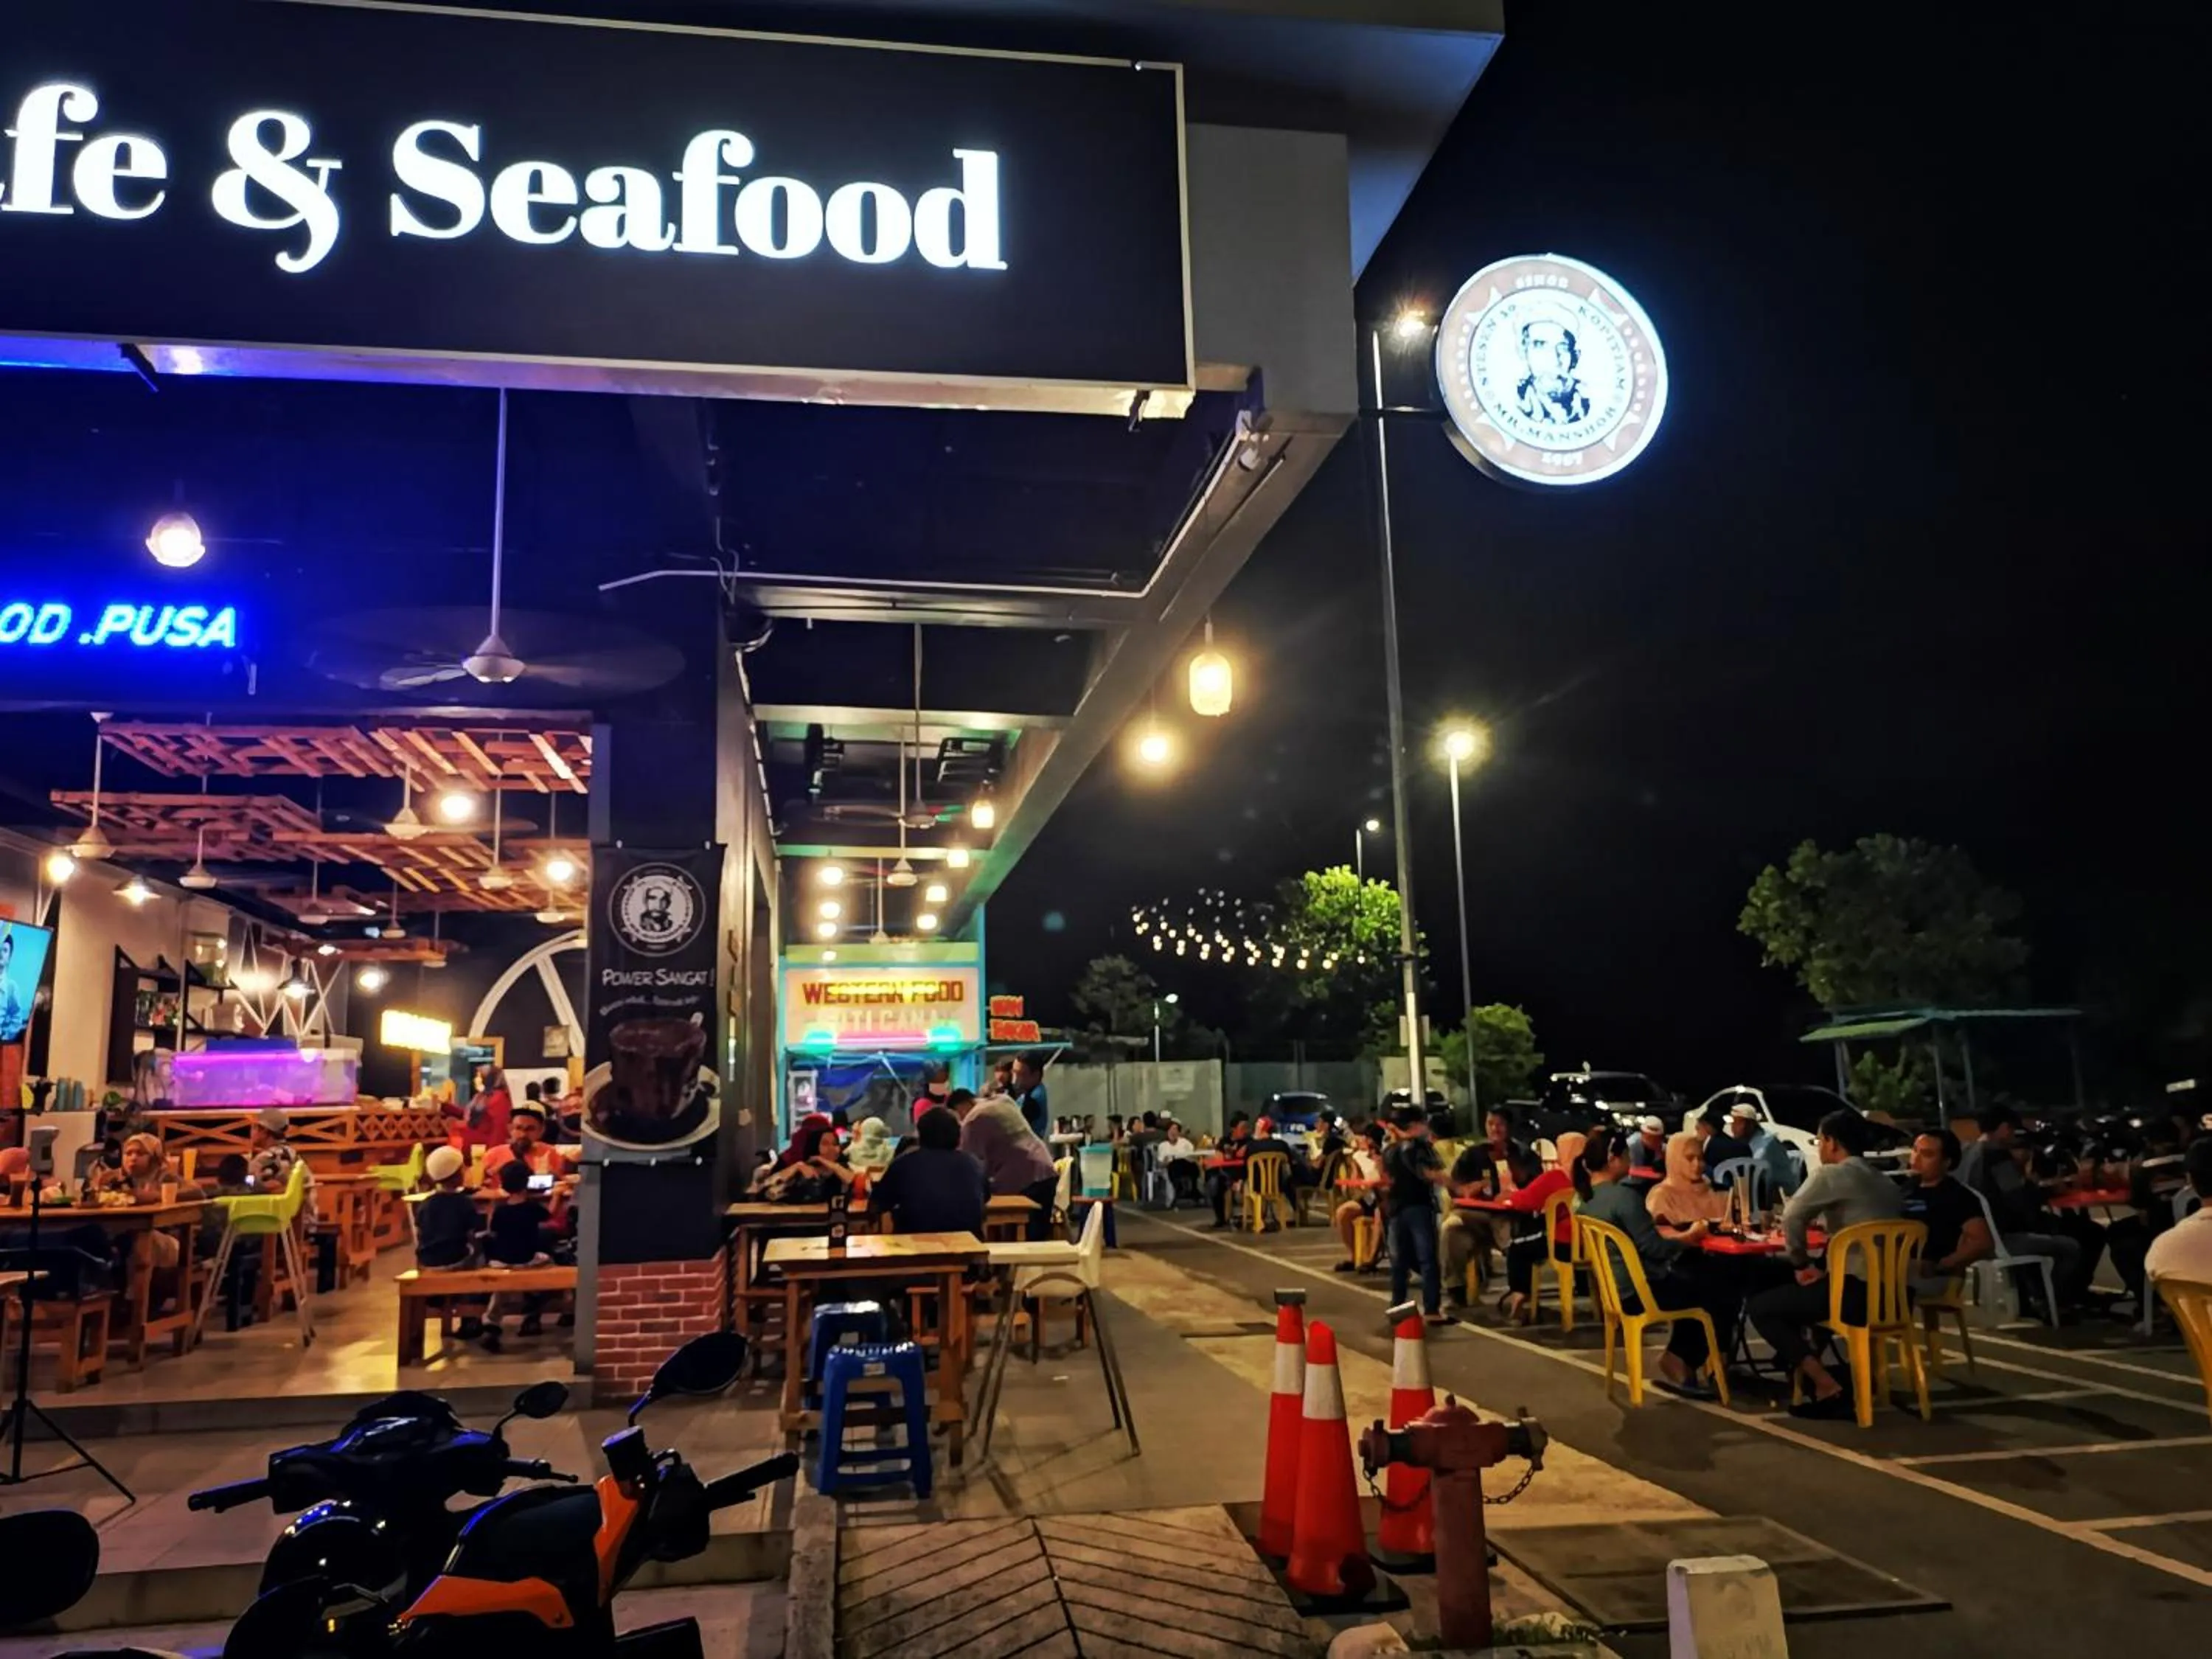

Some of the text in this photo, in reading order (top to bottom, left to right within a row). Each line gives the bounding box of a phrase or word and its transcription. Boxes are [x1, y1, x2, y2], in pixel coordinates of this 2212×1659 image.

[0, 82, 1009, 274] fe & Seafood
[1578, 305, 1627, 391] KOPITIAM
[602, 968, 654, 987] POWER
[801, 981, 964, 1005] WESTERN FOOD
